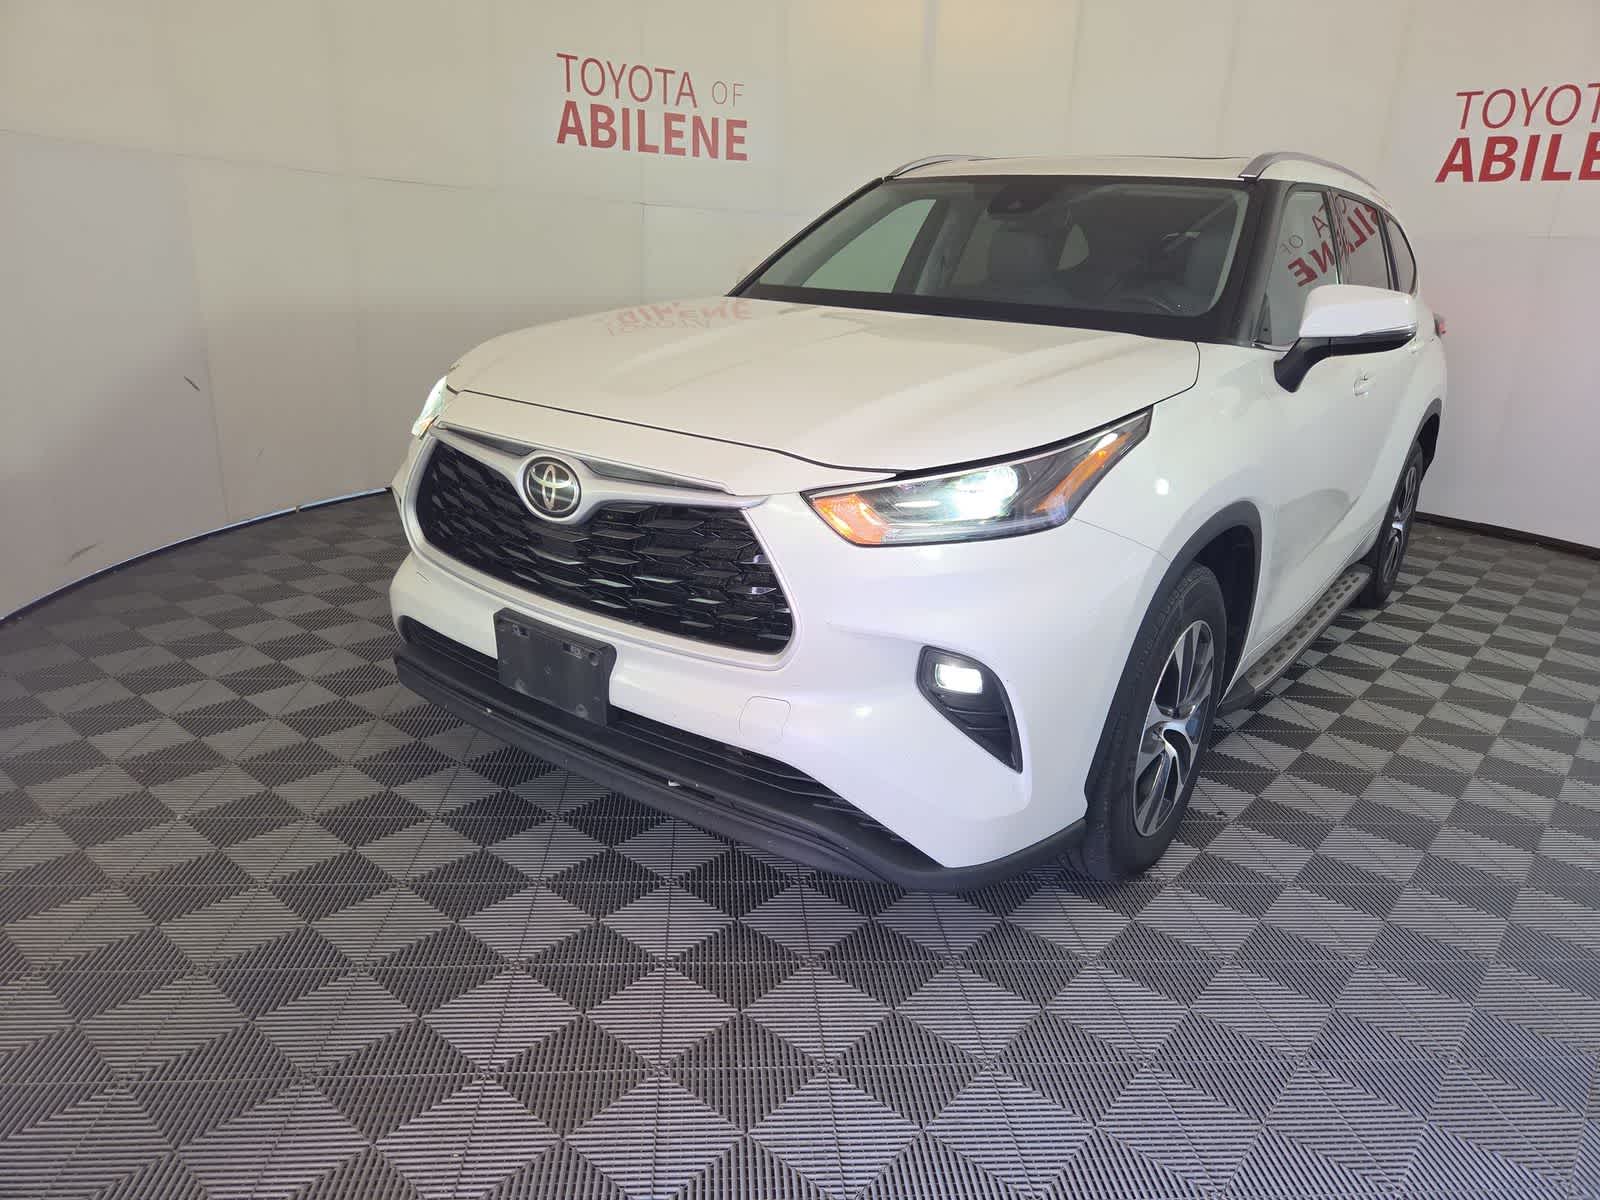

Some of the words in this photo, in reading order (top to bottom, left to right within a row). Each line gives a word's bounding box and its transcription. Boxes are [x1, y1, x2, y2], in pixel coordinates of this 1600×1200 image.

[556, 53, 698, 108] TOYOTA
[711, 81, 745, 106] OF
[556, 100, 748, 161] ABILENE
